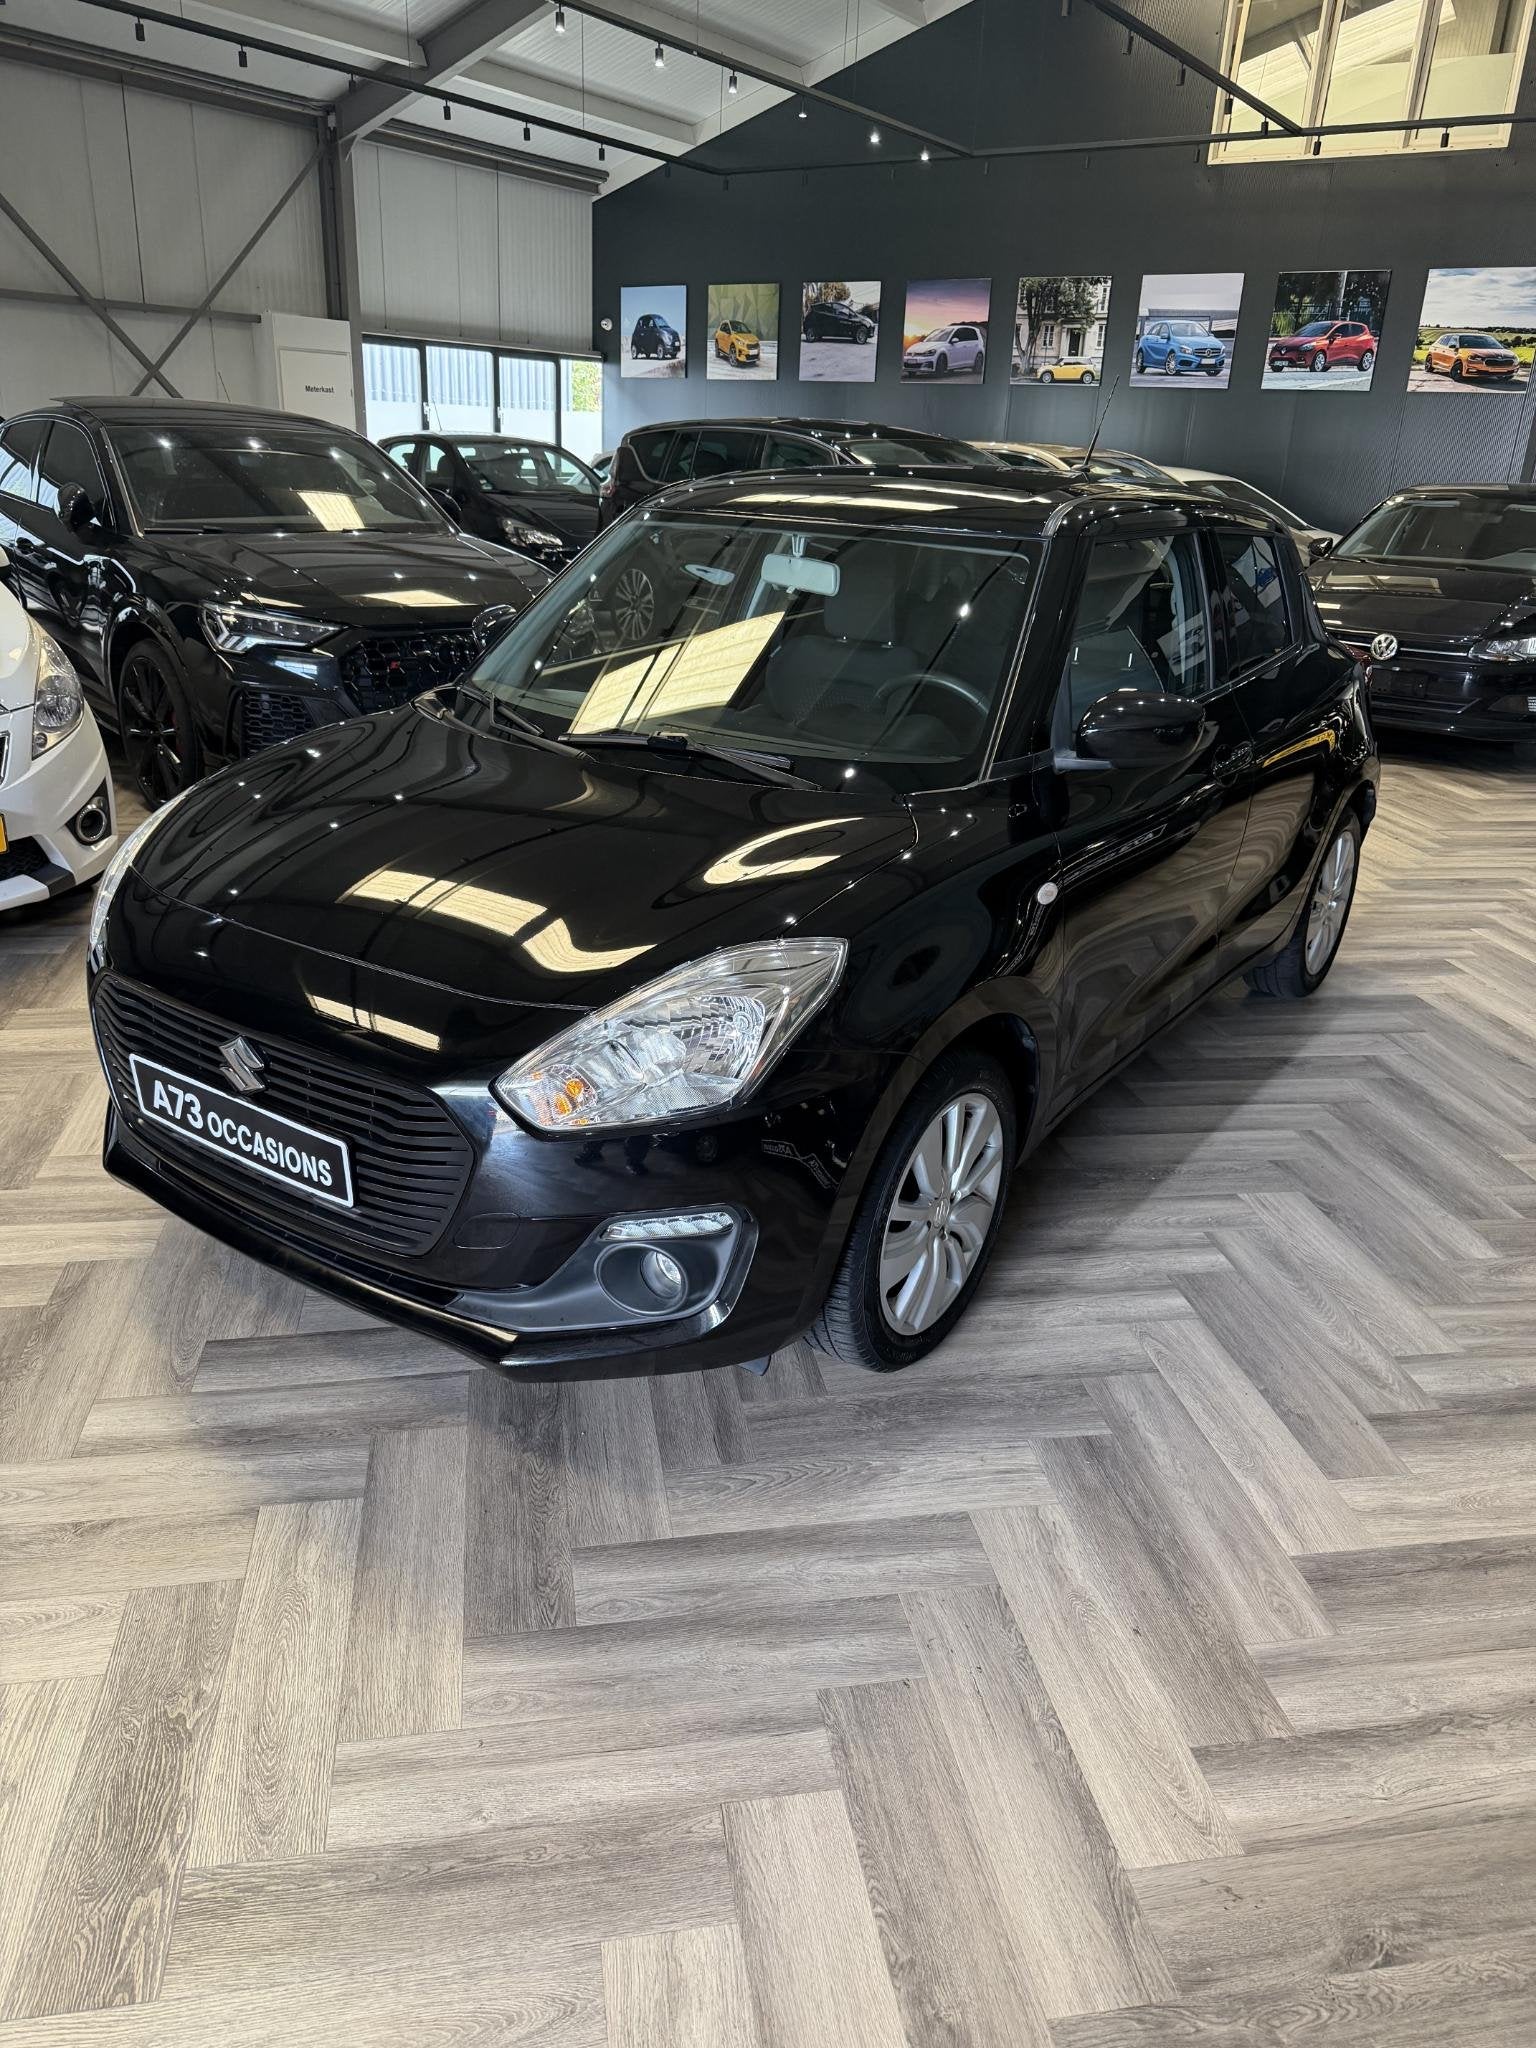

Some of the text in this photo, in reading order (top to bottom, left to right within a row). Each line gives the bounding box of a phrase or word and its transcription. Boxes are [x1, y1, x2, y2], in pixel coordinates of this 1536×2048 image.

[305, 385, 335, 393] Meterkast
[153, 1079, 333, 1187] A73 OCCASIONS
